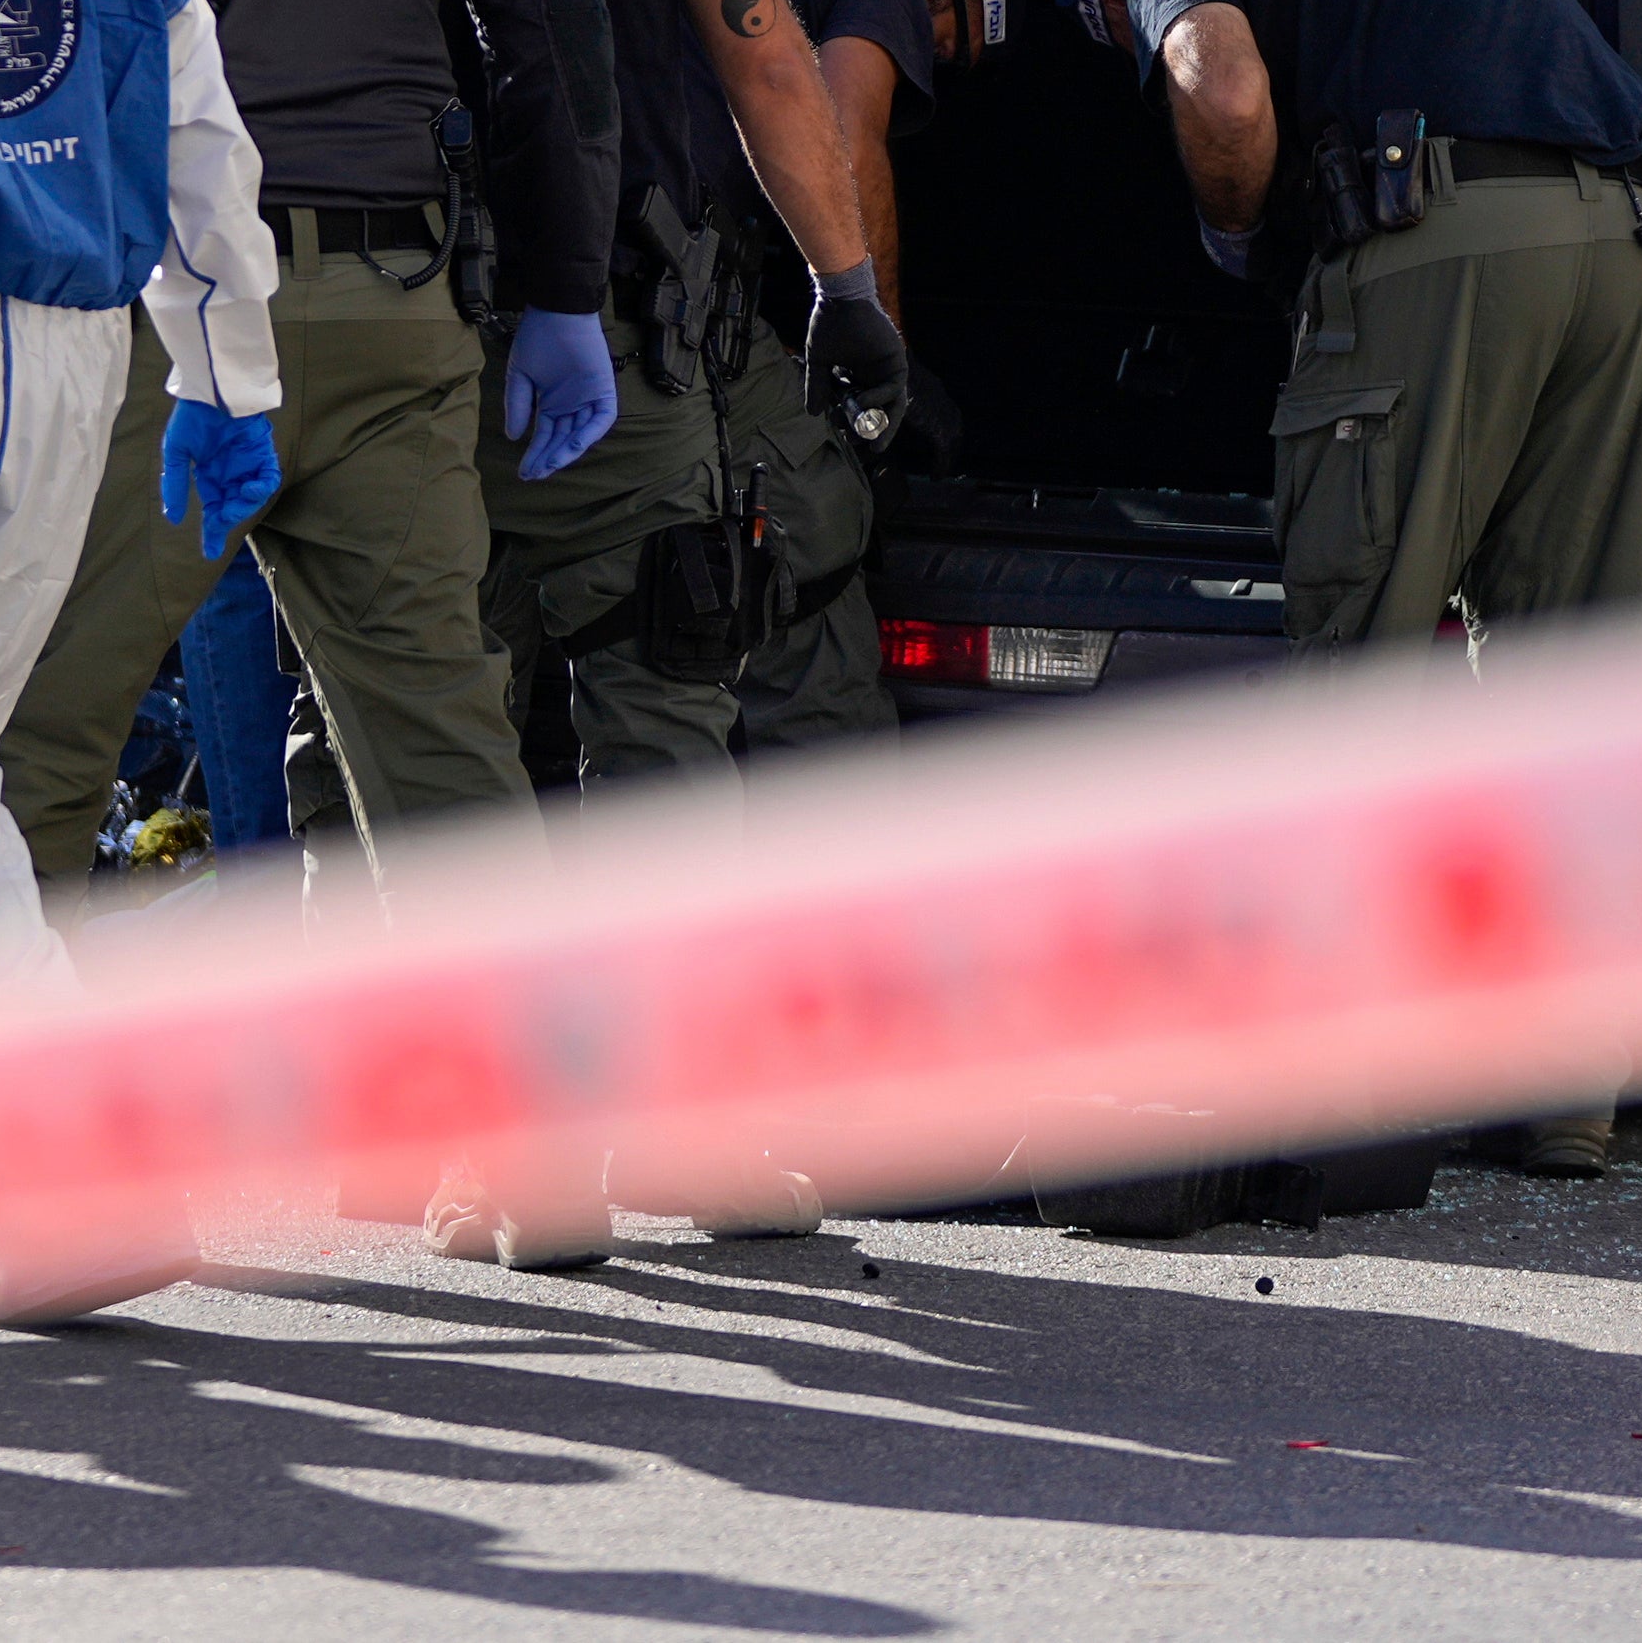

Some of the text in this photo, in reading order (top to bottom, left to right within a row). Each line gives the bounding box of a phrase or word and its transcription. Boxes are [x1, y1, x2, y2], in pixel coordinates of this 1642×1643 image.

[986, 0, 1002, 39] חבלן
[39, 32, 76, 89] משטרת
[0, 85, 41, 113] ישראל
[13, 136, 79, 165] זיהוי
